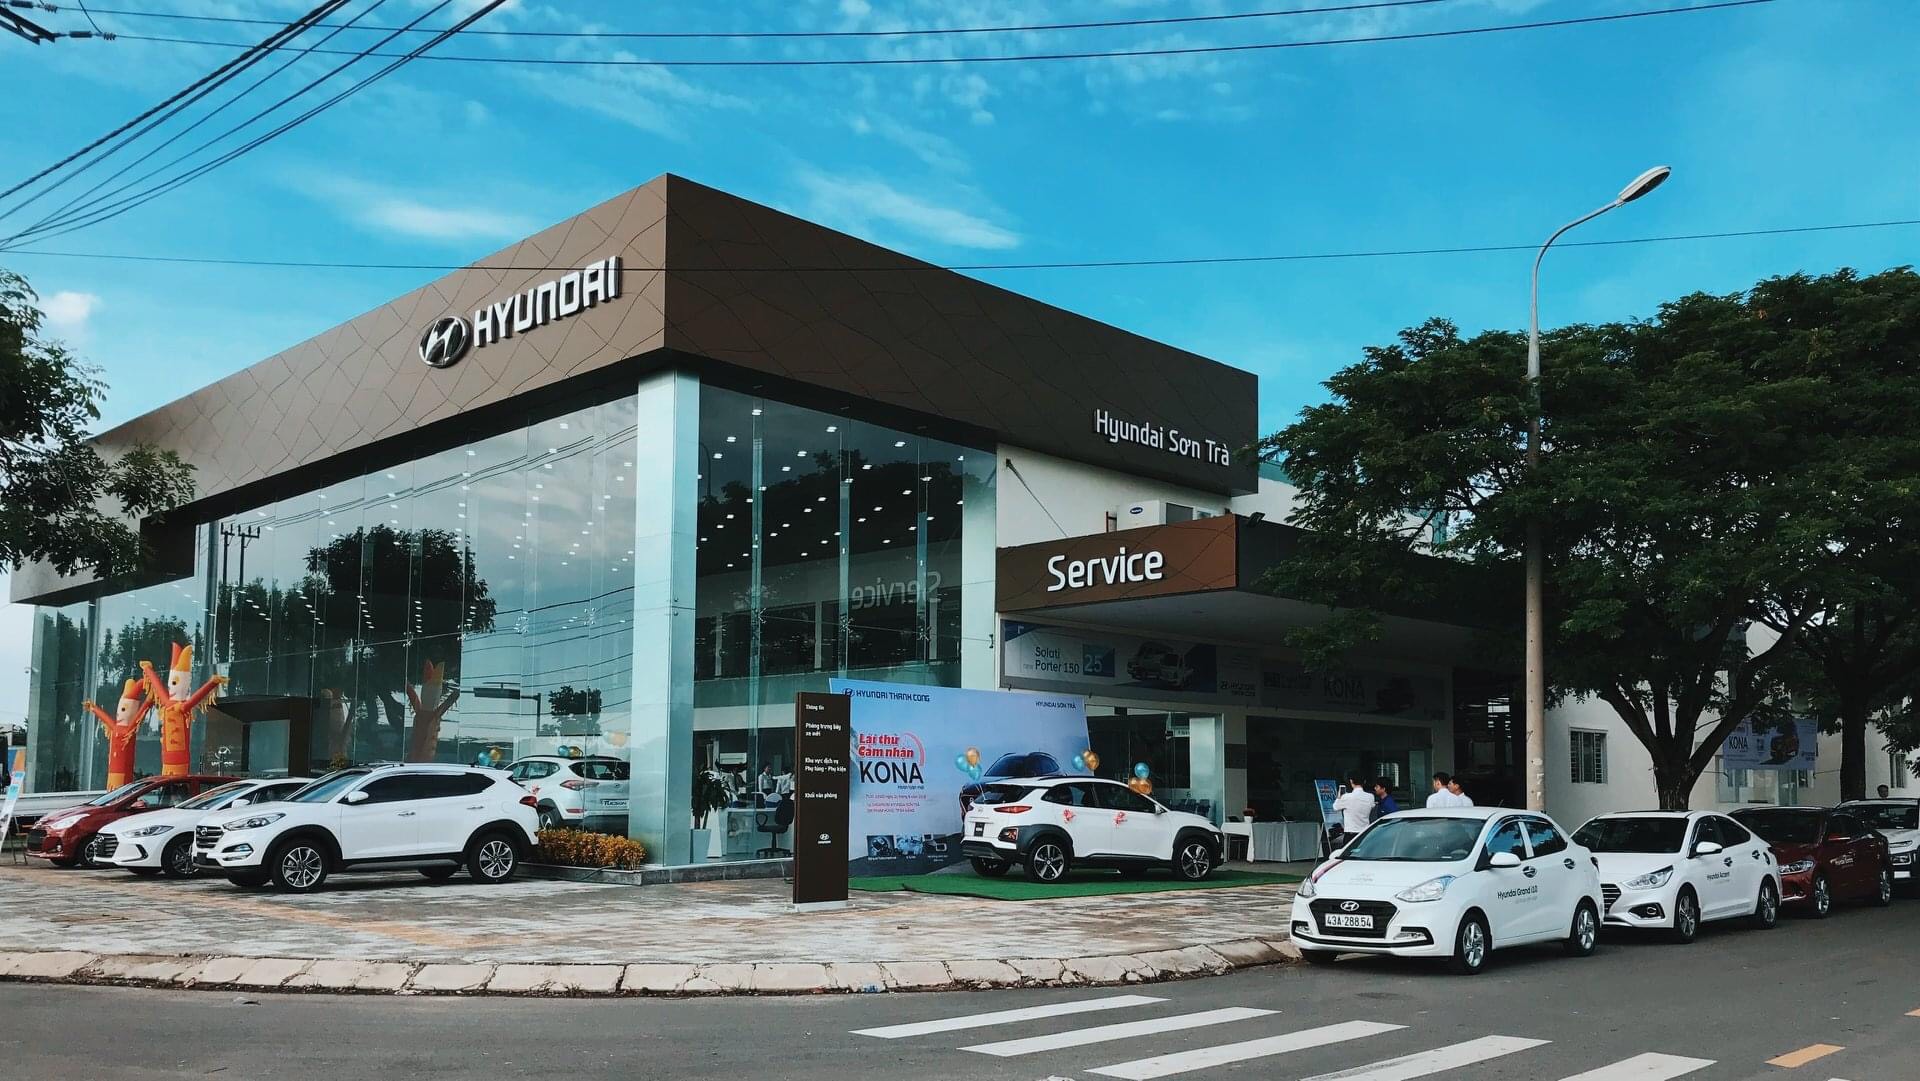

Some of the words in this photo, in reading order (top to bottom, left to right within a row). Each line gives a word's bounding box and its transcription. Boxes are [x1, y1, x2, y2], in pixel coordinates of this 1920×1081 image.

[474, 255, 622, 348] HYUNDAI
[1096, 408, 1164, 449] Hyundai
[1168, 428, 1201, 460] Sơn
[1205, 438, 1230, 467] Trà
[1047, 546, 1164, 592] Service
[1035, 646, 1061, 659] Solati
[1035, 659, 1063, 673] Porter
[1063, 662, 1081, 674] 150
[1084, 653, 1104, 673] 25
[856, 689, 889, 699] HYUNDAI
[1728, 736, 1749, 750] KONA
[860, 760, 924, 784] KONA
[1497, 889, 1517, 900] Hyundai
